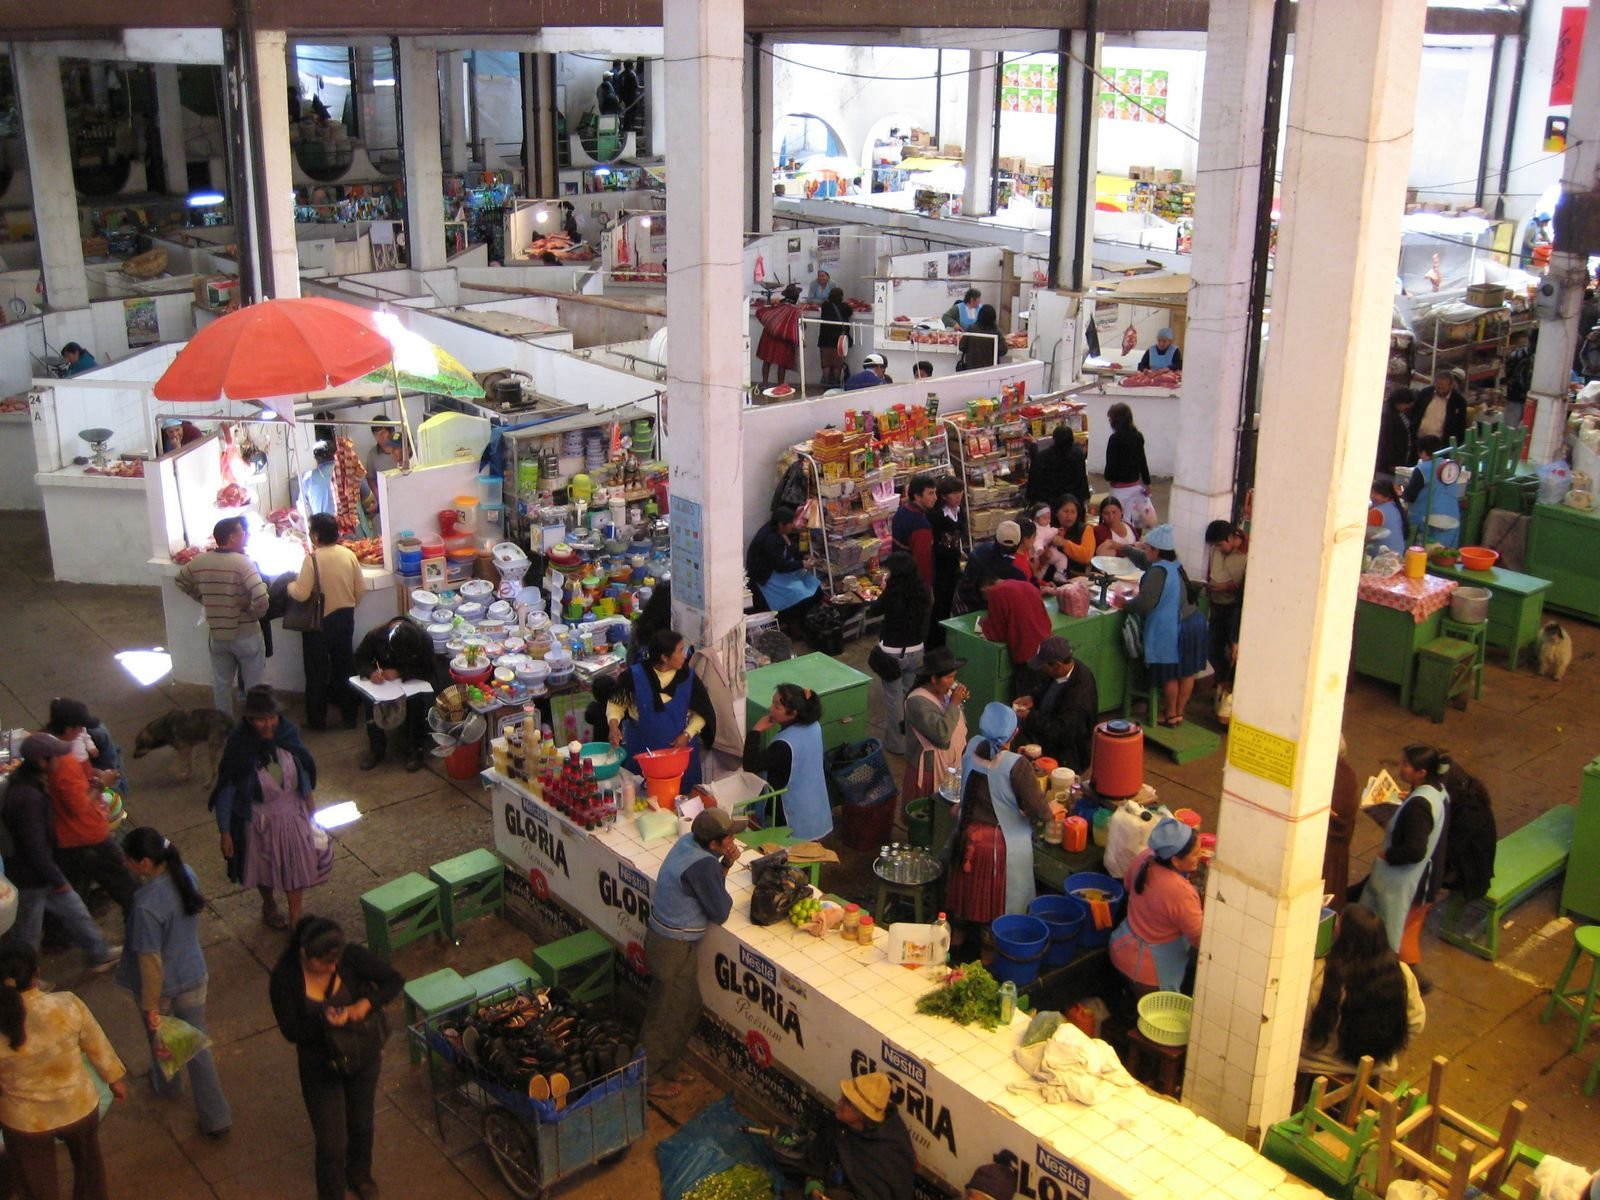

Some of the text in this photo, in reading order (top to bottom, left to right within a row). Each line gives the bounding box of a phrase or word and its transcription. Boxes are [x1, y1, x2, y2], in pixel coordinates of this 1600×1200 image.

[29, 395, 41, 405] 24
[34, 411, 42, 421] A
[505, 803, 570, 880] GLORIA
[599, 868, 653, 929] GLOR
[741, 948, 775, 983] Nestlé
[714, 952, 804, 1050] GLORIA
[883, 1045, 925, 1083] Nestlé
[1039, 1149, 1087, 1192] Nestlé
